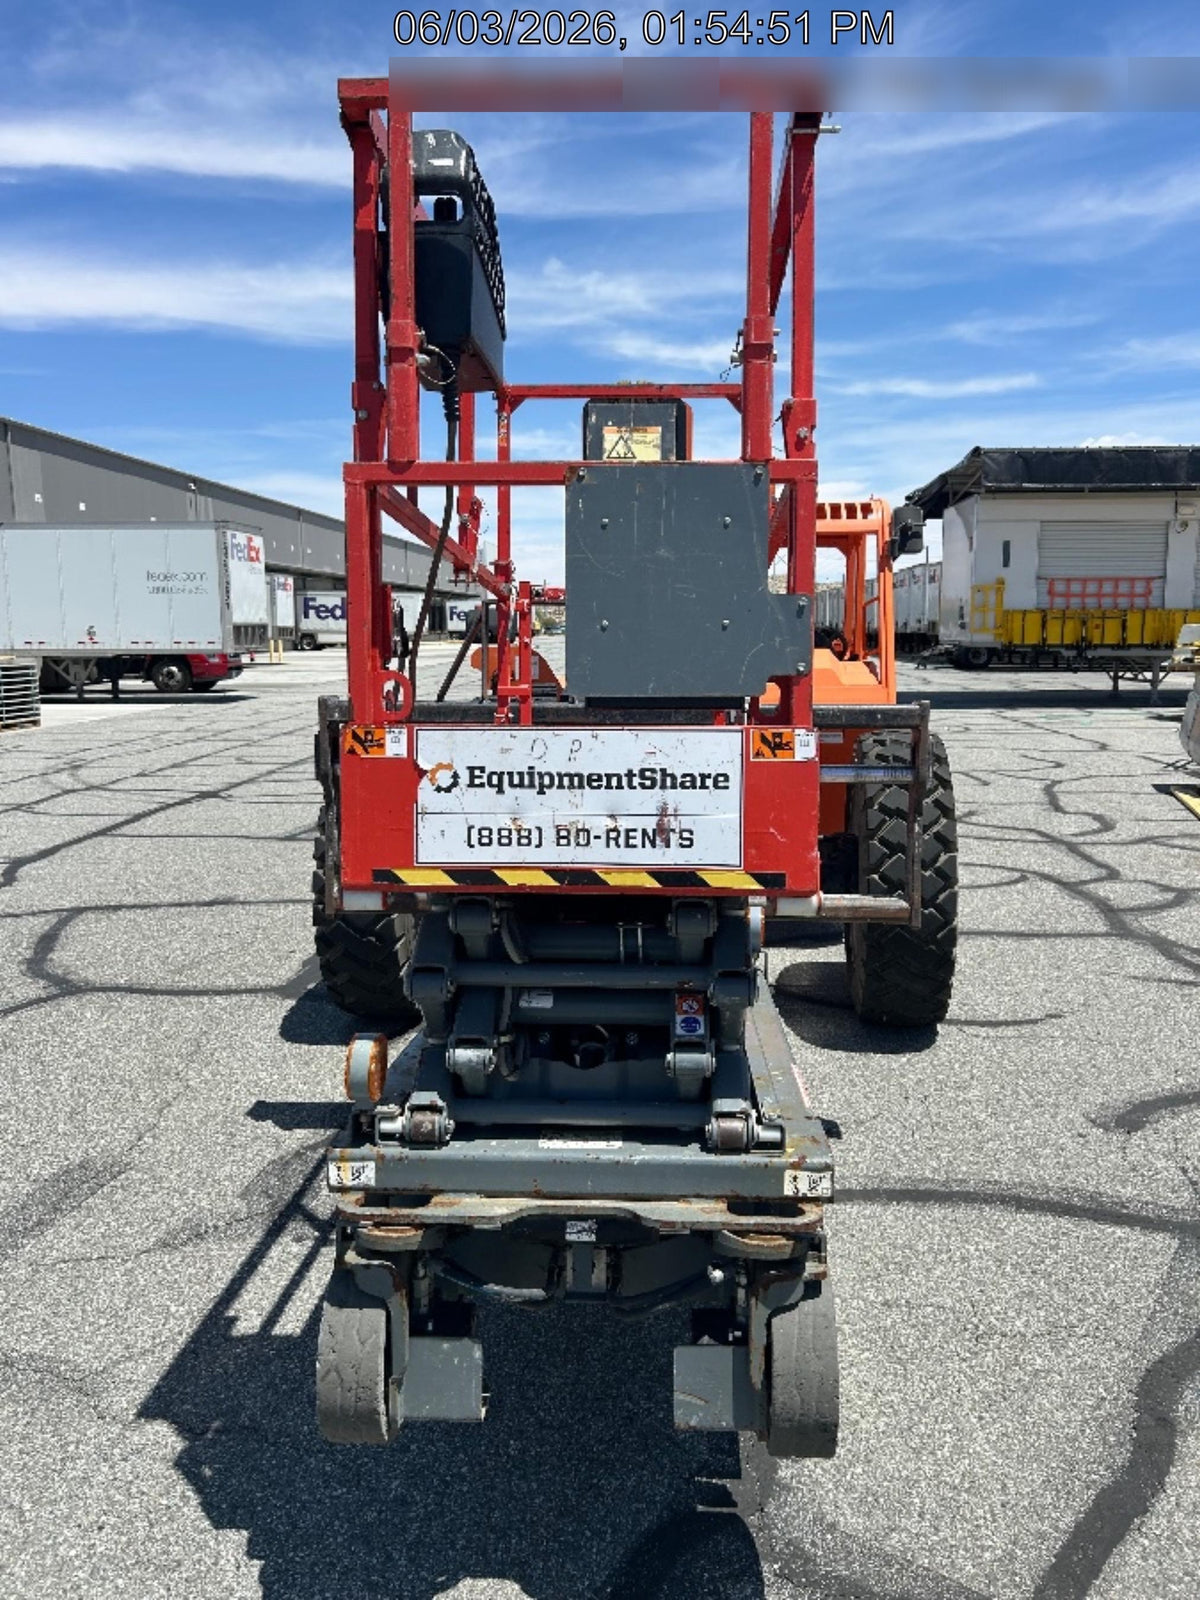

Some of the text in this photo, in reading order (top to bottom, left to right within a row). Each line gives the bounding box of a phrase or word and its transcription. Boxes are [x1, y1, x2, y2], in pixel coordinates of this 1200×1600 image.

[303, 596, 346, 621] Fed
[466, 765, 730, 796] EquipmentShare
[467, 825, 543, 849] (888)
